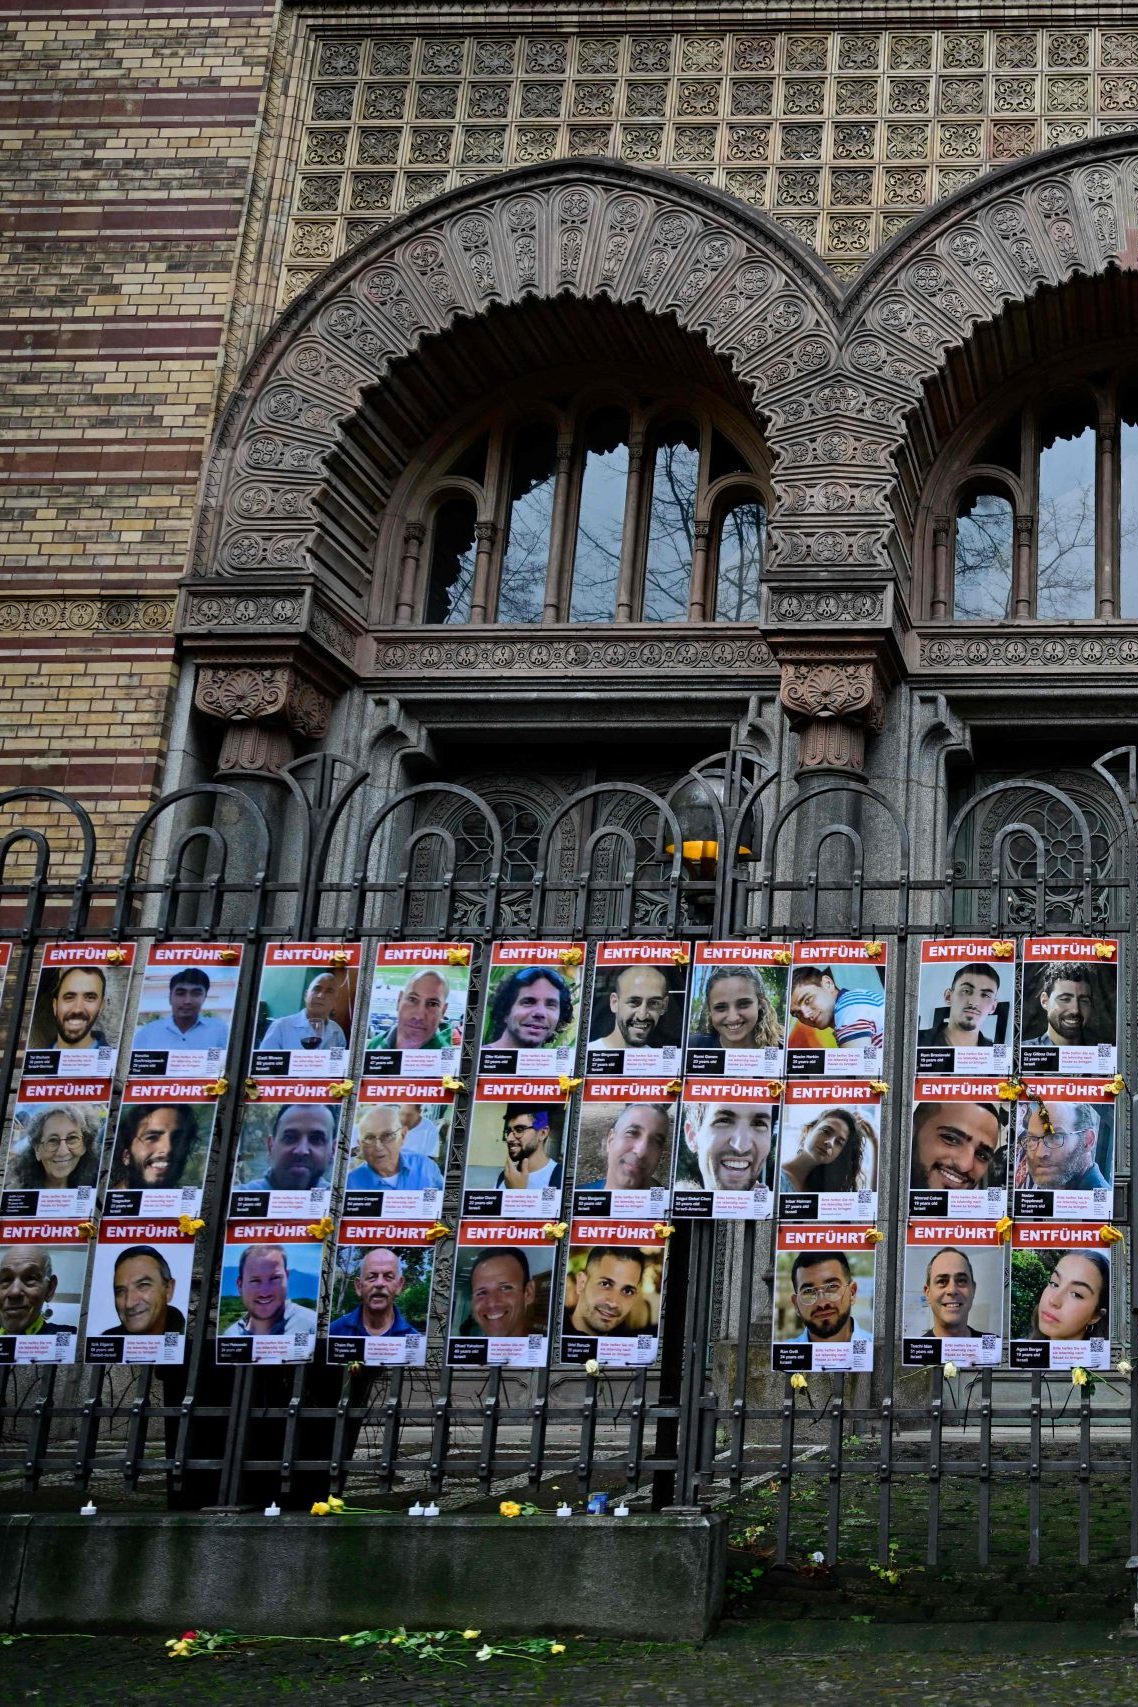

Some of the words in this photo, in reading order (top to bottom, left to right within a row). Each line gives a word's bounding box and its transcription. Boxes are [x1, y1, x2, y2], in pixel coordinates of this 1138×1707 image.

[25, 1084, 104, 1097] ENTFÜHRT
[367, 1084, 446, 1097] ENTFÜHRT
[591, 1084, 669, 1096] ENTFÜHRT
[793, 1086, 871, 1098] ENTFÜHRT
[346, 1226, 428, 1239] ENTFÜHRT
[786, 1230, 865, 1244] ENTFÜHRT
[915, 1225, 996, 1239] ENTFÜHRT
[1020, 1228, 1101, 1242] ENTFÜHRT
